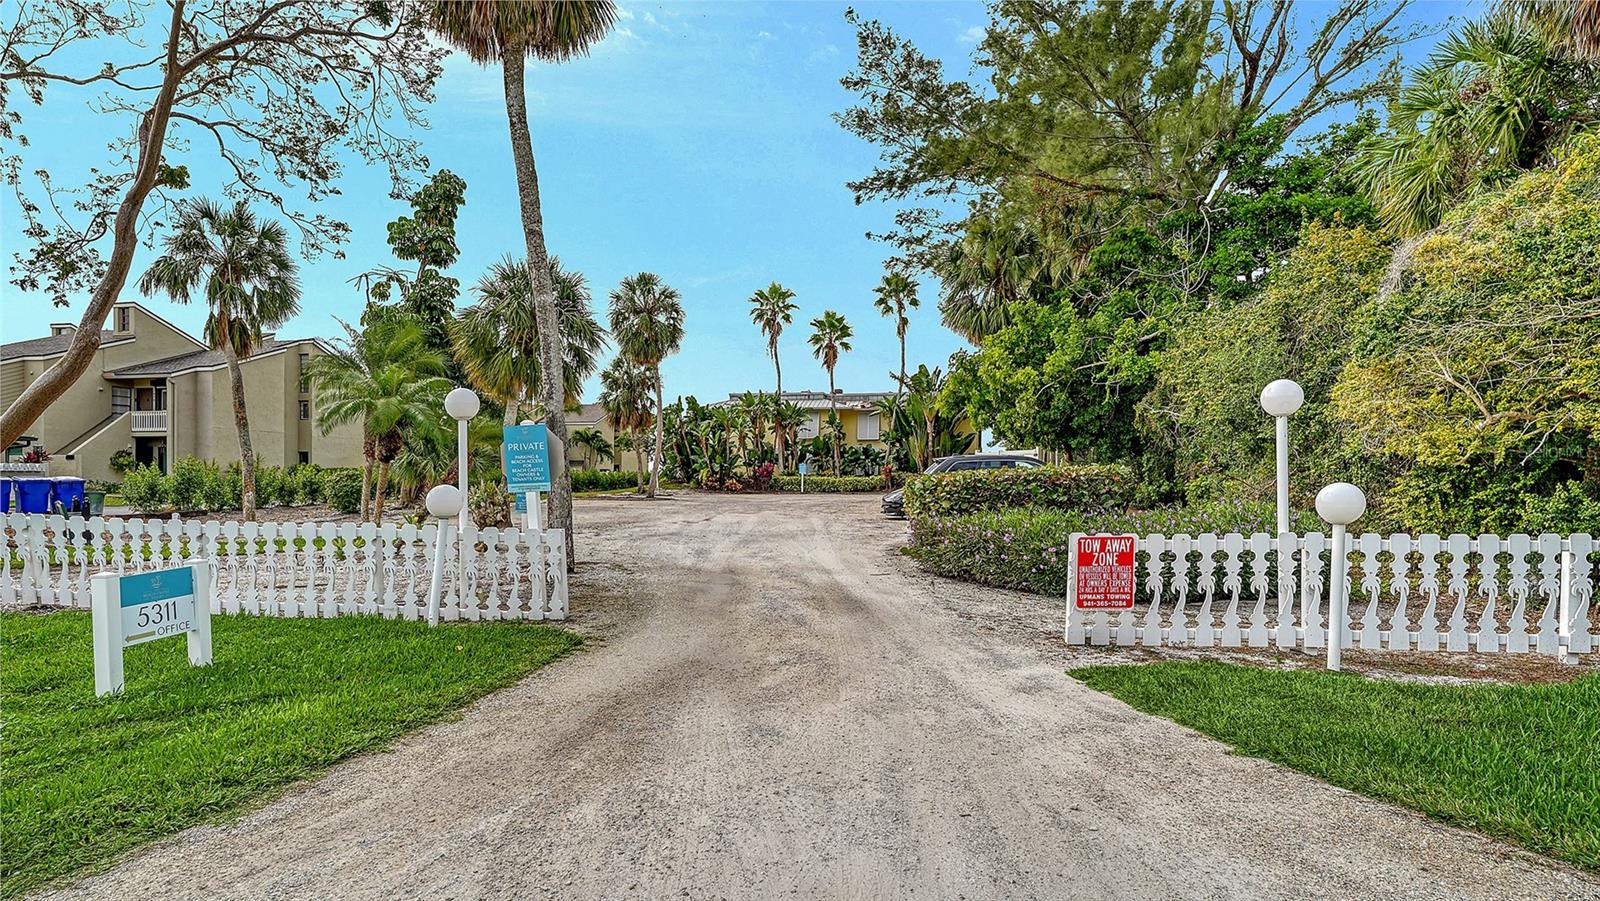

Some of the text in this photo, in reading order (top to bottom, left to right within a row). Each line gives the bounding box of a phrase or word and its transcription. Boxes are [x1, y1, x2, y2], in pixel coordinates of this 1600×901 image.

[507, 442, 545, 451] PRIVATE
[1079, 539, 1132, 553] TOW AWAY
[1092, 552, 1119, 566] ZONE
[137, 601, 178, 628] 5311
[157, 620, 191, 636] OFFICE
